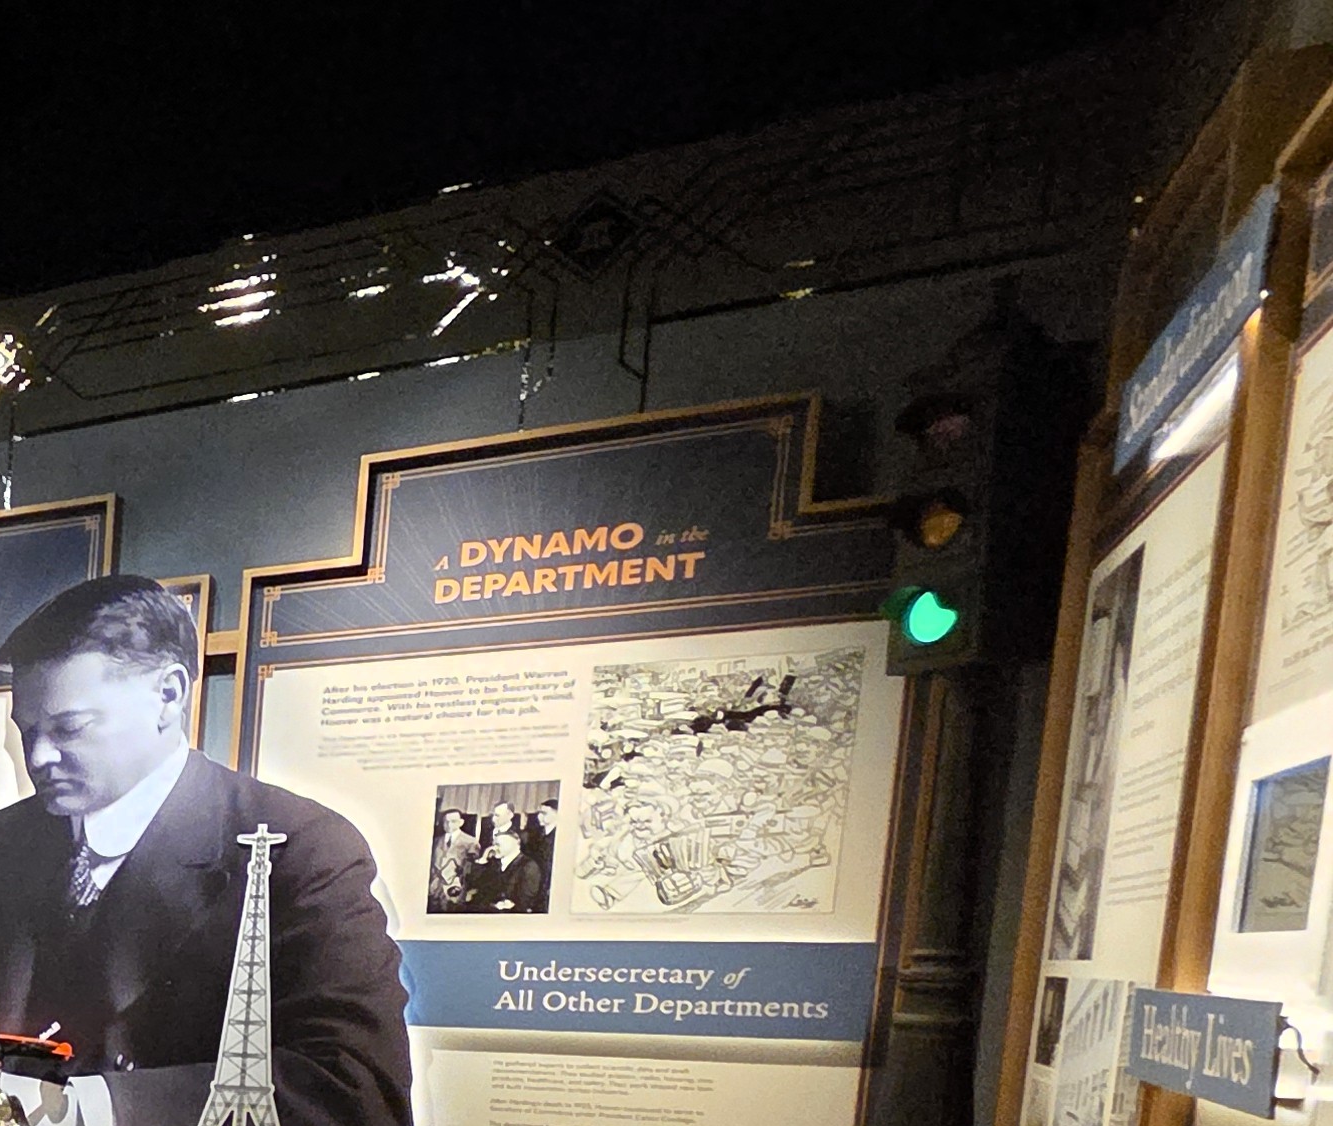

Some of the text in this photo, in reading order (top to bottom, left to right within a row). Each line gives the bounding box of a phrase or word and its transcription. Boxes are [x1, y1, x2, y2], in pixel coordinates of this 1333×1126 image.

[434, 522, 710, 571] A DYNAMO in the
[434, 551, 706, 605] DEPARTMENT
[499, 960, 751, 990] Undersecretary of
[493, 990, 829, 1021] All Other Departments
[1140, 1004, 1254, 1090] Healthy Lives
